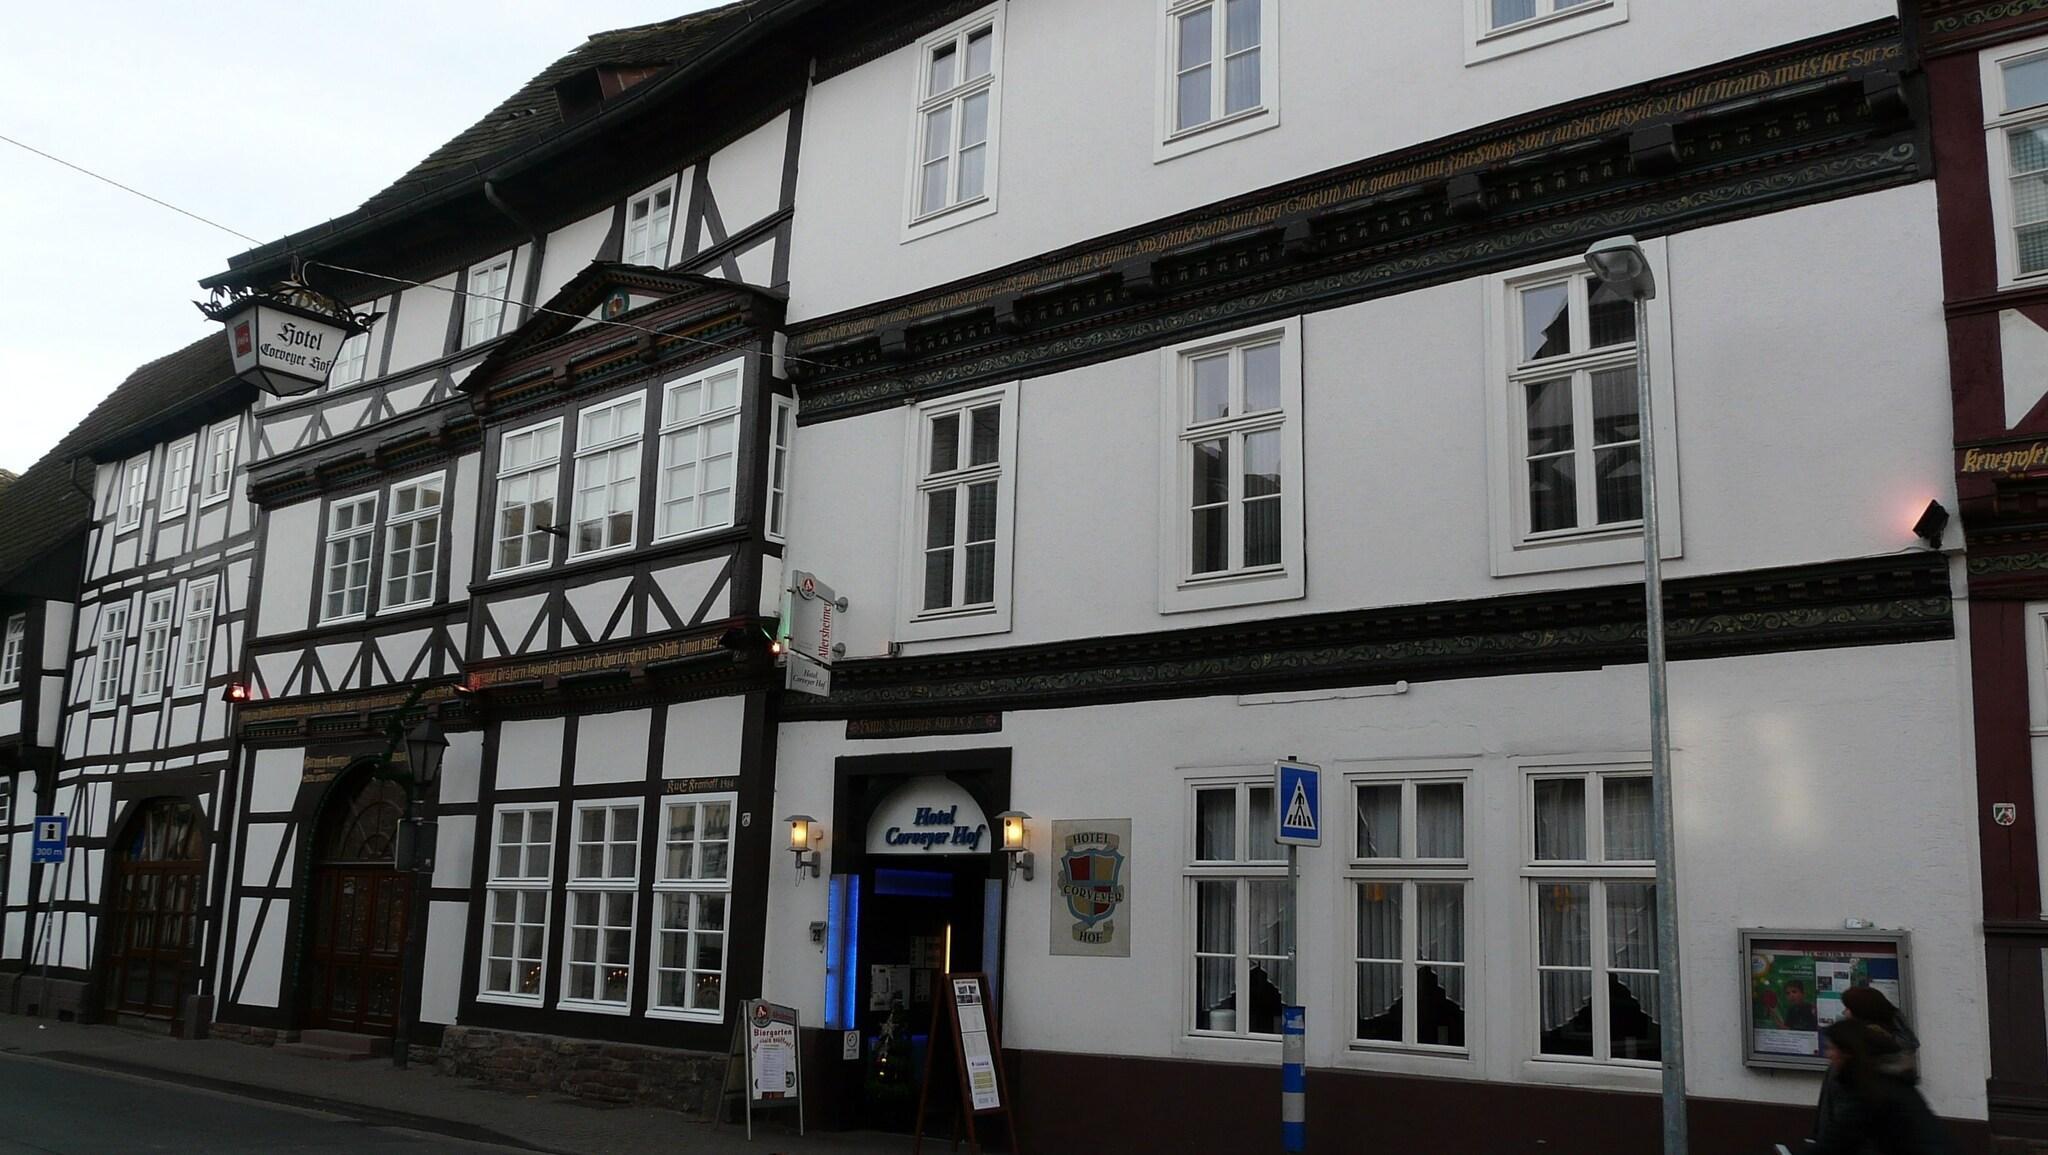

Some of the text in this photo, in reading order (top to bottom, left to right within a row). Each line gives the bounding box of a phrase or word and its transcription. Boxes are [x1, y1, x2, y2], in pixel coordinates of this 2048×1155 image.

[277, 322, 323, 351] Hotel
[260, 342, 332, 375] Corveyer Hof
[818, 602, 833, 659] Allersheimer
[792, 674, 827, 690] Corveyer Hof
[803, 668, 818, 680] Hotel
[913, 805, 958, 826] Hotel
[886, 824, 986, 850] Corveyer Hof
[1072, 833, 1111, 845] HOTEL
[1063, 885, 1123, 903] CORVEYER
[1079, 931, 1104, 942] HOF
[753, 1029, 793, 1037] Biergarten
